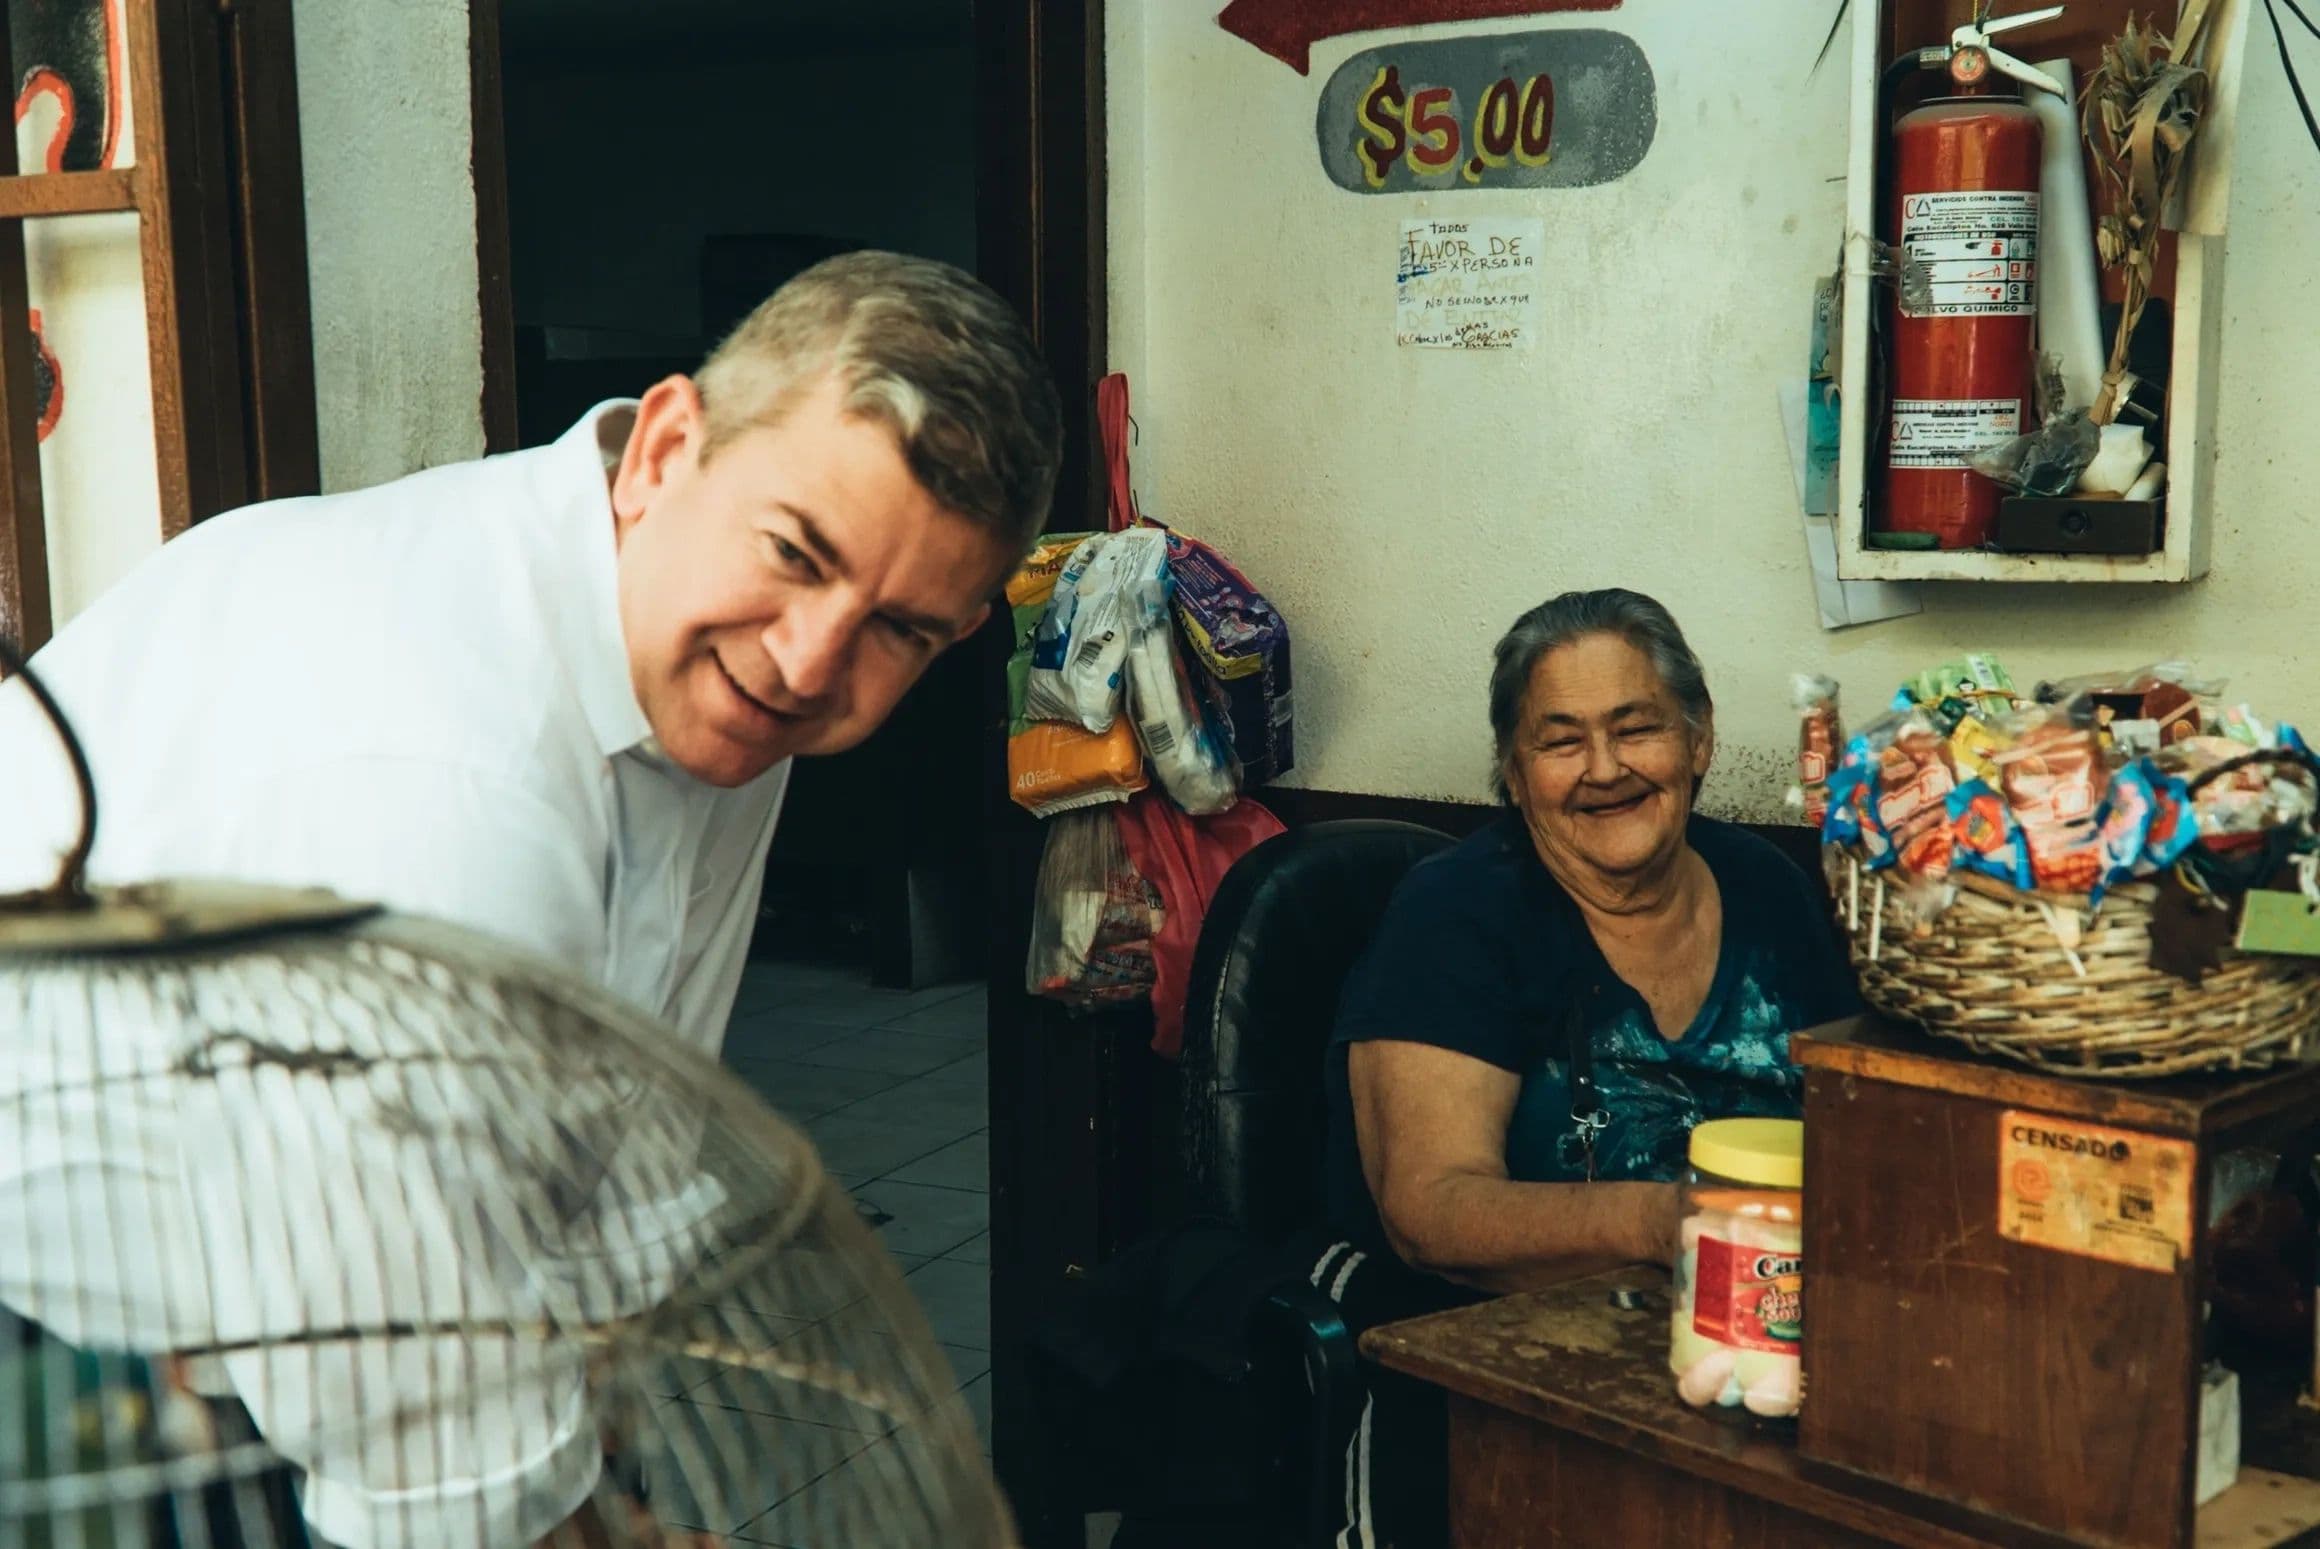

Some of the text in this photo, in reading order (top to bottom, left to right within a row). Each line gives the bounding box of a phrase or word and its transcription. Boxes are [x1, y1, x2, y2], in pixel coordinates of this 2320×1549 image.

[1357, 65, 1555, 188] $5.00
[1405, 229, 1476, 267] FAVOR
[1488, 236, 1523, 257] DE
[1962, 304, 2019, 313] QUIMICO
[1016, 769, 1035, 790] 40
[2011, 1125, 2132, 1163] CENSADO
